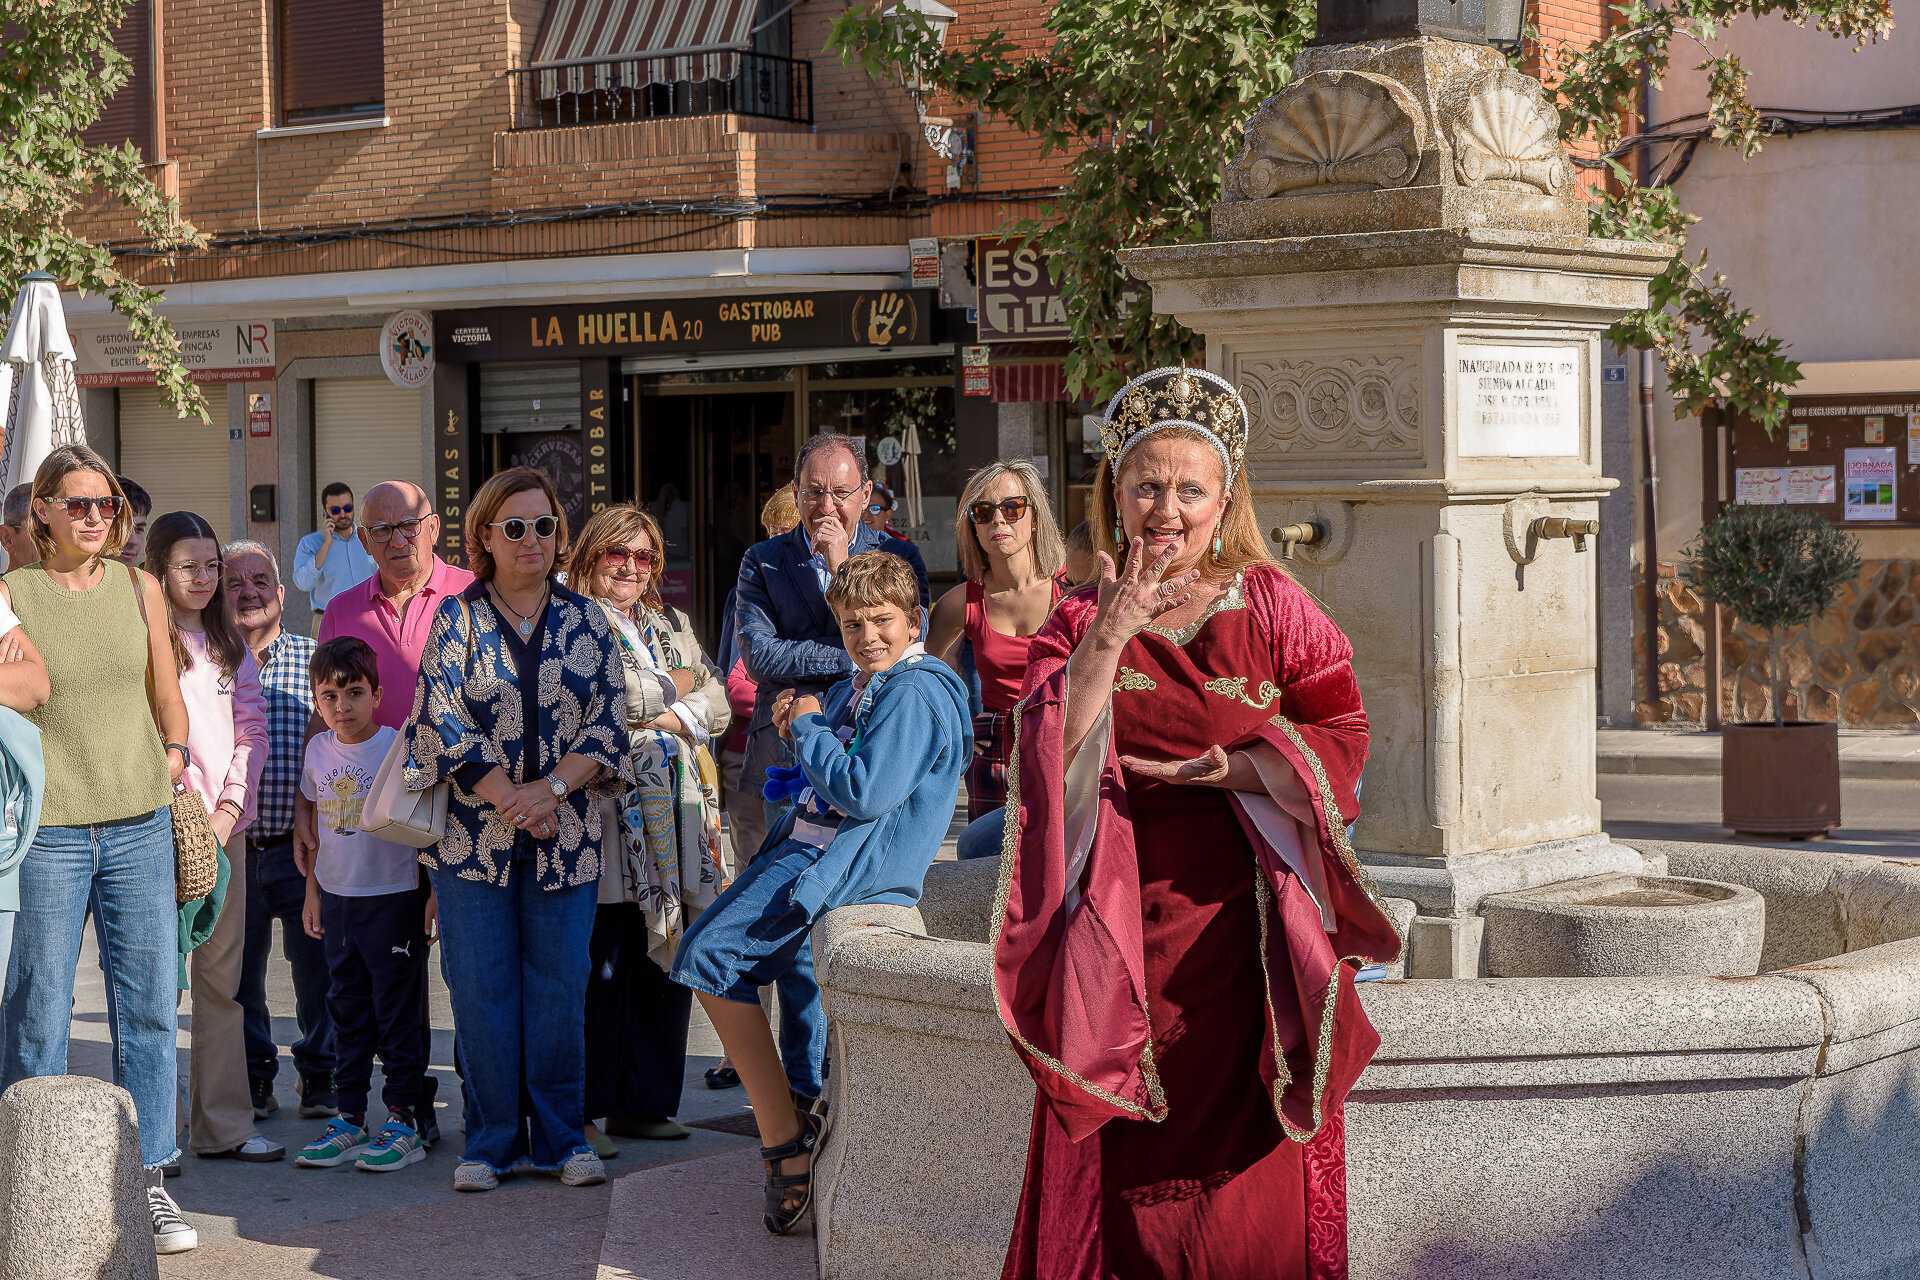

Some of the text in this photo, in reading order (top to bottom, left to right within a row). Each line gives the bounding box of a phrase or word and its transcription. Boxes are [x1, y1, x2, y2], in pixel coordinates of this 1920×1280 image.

[719, 300, 815, 321] GASTROBAR
[393, 317, 427, 337] VICTORIA
[455, 327, 489, 335] CERVEZAS
[531, 310, 703, 347] LA HUELLA 2.0
[751, 323, 781, 342] PUB
[96, 332, 129, 345] GESTIÓN
[182, 329, 220, 340] EMPRESAS
[236, 324, 269, 355] NR
[452, 334, 491, 343] VICTORIA
[184, 342, 213, 352] FINCAS
[180, 354, 206, 365] UESTOS
[1458, 359, 1522, 374] INAUGURADA
[1524, 361, 1536, 374] EL
[84, 374, 98, 385] 370
[99, 374, 113, 385] 289
[119, 375, 157, 384] www.nr-as
[399, 364, 428, 381] MÁLAGA
[1610, 369, 1618, 381] 5
[1478, 377, 1557, 391] SIENDO ALCALDE
[1792, 408, 1807, 417] USO
[1808, 406, 1847, 416] EXCLUSIVO
[1848, 404, 1903, 416] AYUNTAMIENTO
[1904, 404, 1915, 414] DE
[234, 430, 239, 439] 3
[529, 440, 583, 466] CERVEZAS
[589, 389, 606, 513] STROBAR
[1851, 461, 1894, 469] JORNADA
[445, 448, 461, 565] SHISHAS
[319, 797, 365, 814] SUMME
